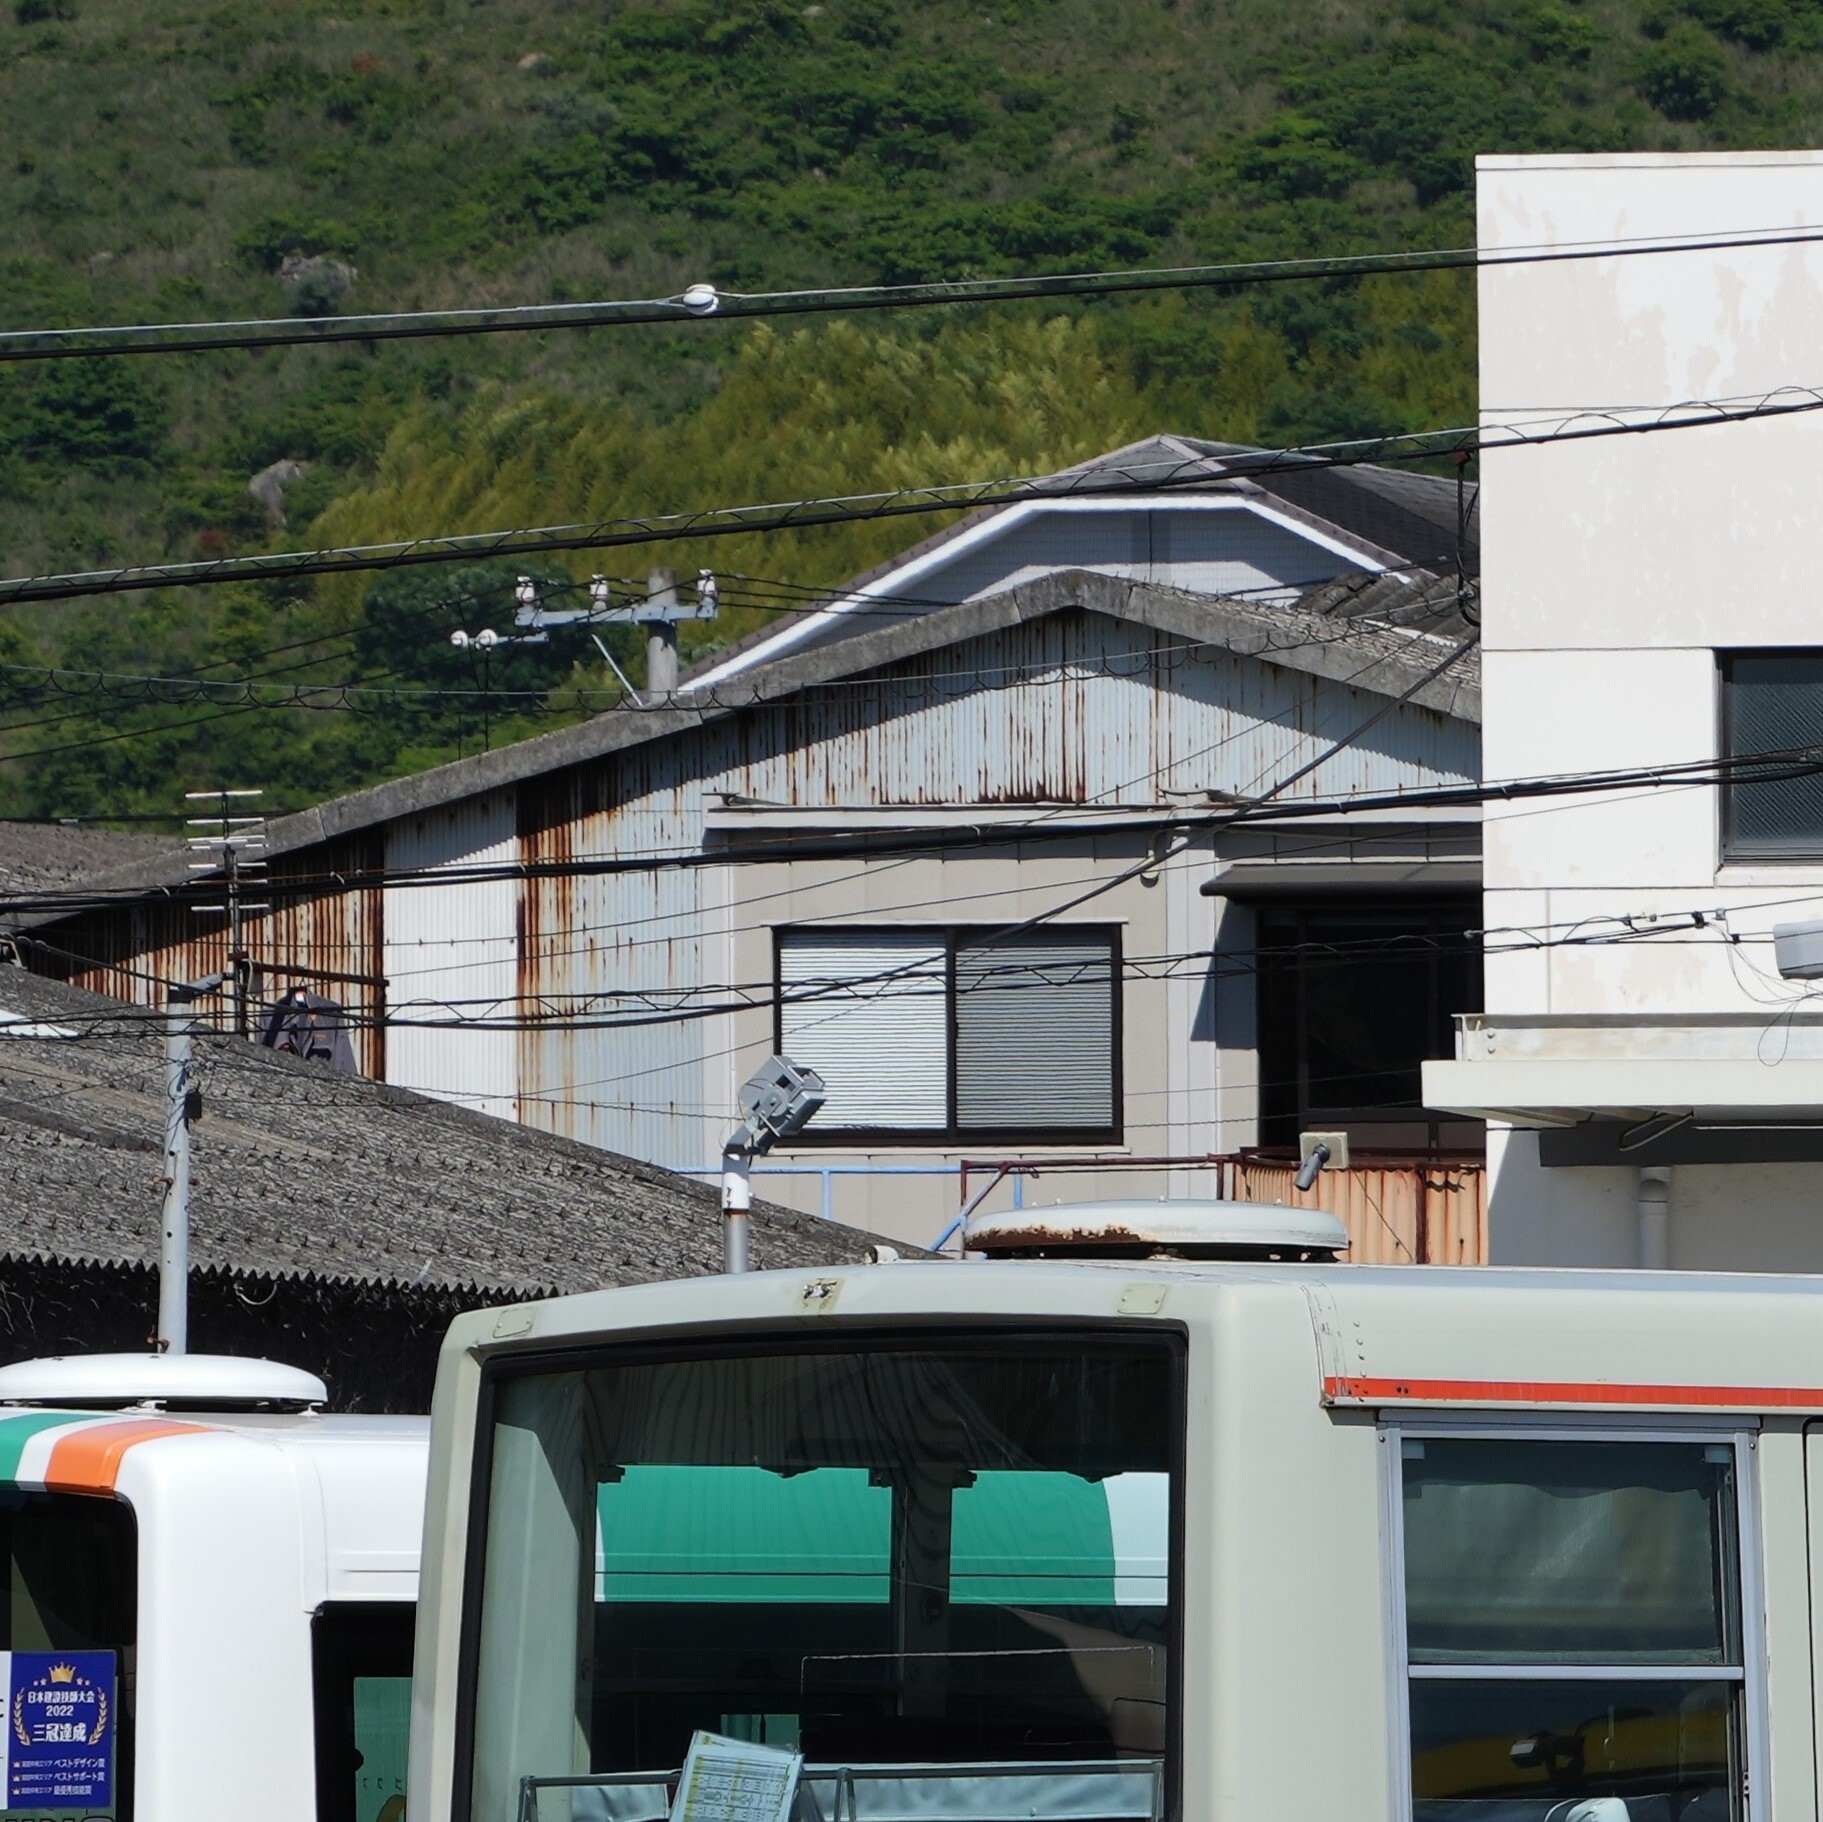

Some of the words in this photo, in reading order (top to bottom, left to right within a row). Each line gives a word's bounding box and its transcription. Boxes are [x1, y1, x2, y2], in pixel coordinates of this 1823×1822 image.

[45, 1704, 74, 1717] 2022
[32, 1722, 87, 1742] 三冠達成
